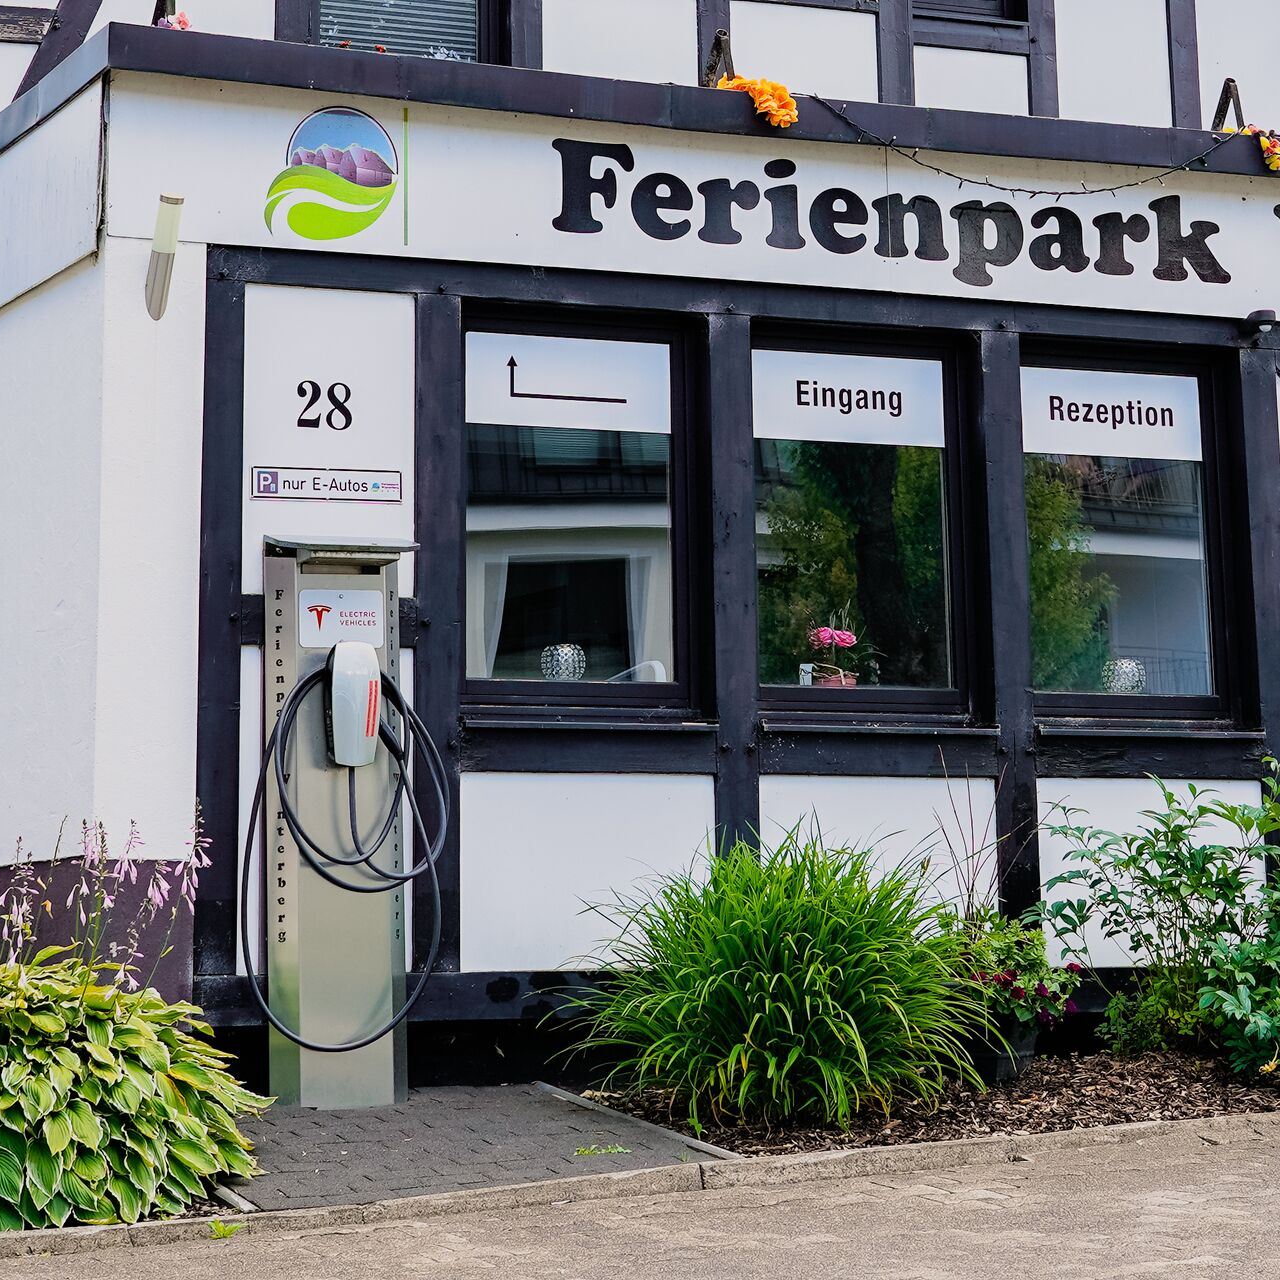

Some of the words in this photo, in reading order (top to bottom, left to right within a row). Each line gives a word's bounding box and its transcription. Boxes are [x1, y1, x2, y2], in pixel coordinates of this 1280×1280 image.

[551, 137, 1232, 287] Ferienpark
[296, 380, 353, 431] 28
[796, 379, 902, 418] Eingang
[1049, 395, 1174, 430] Rezeption
[282, 479, 307, 491] nur
[312, 476, 369, 493] E-Autos
[339, 610, 376, 618] ELECTRIC
[339, 619, 377, 627] VEHICLES
